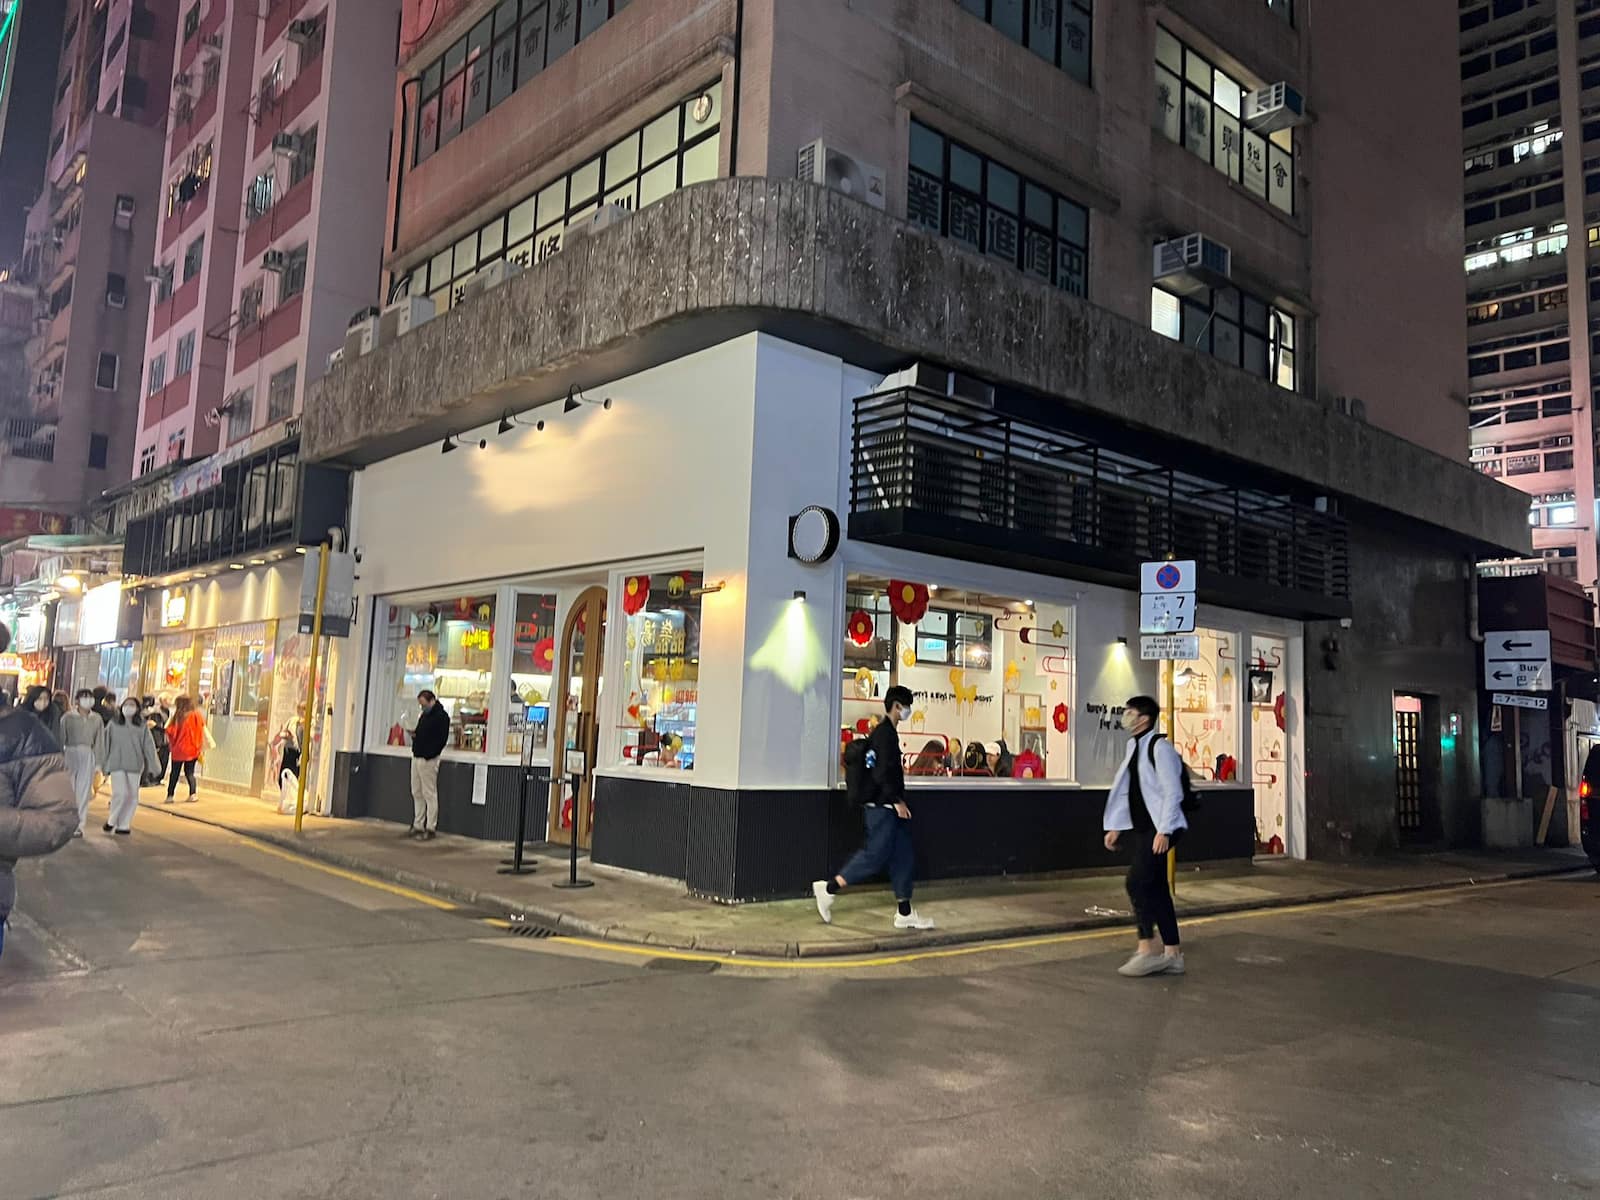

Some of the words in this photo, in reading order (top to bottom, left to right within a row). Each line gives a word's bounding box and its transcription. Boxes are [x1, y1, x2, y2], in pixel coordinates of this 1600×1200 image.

[1176, 596, 1185, 609] 7
[1175, 616, 1185, 629] 7
[1519, 664, 1539, 672] Bus
[1534, 699, 1546, 707] 12
